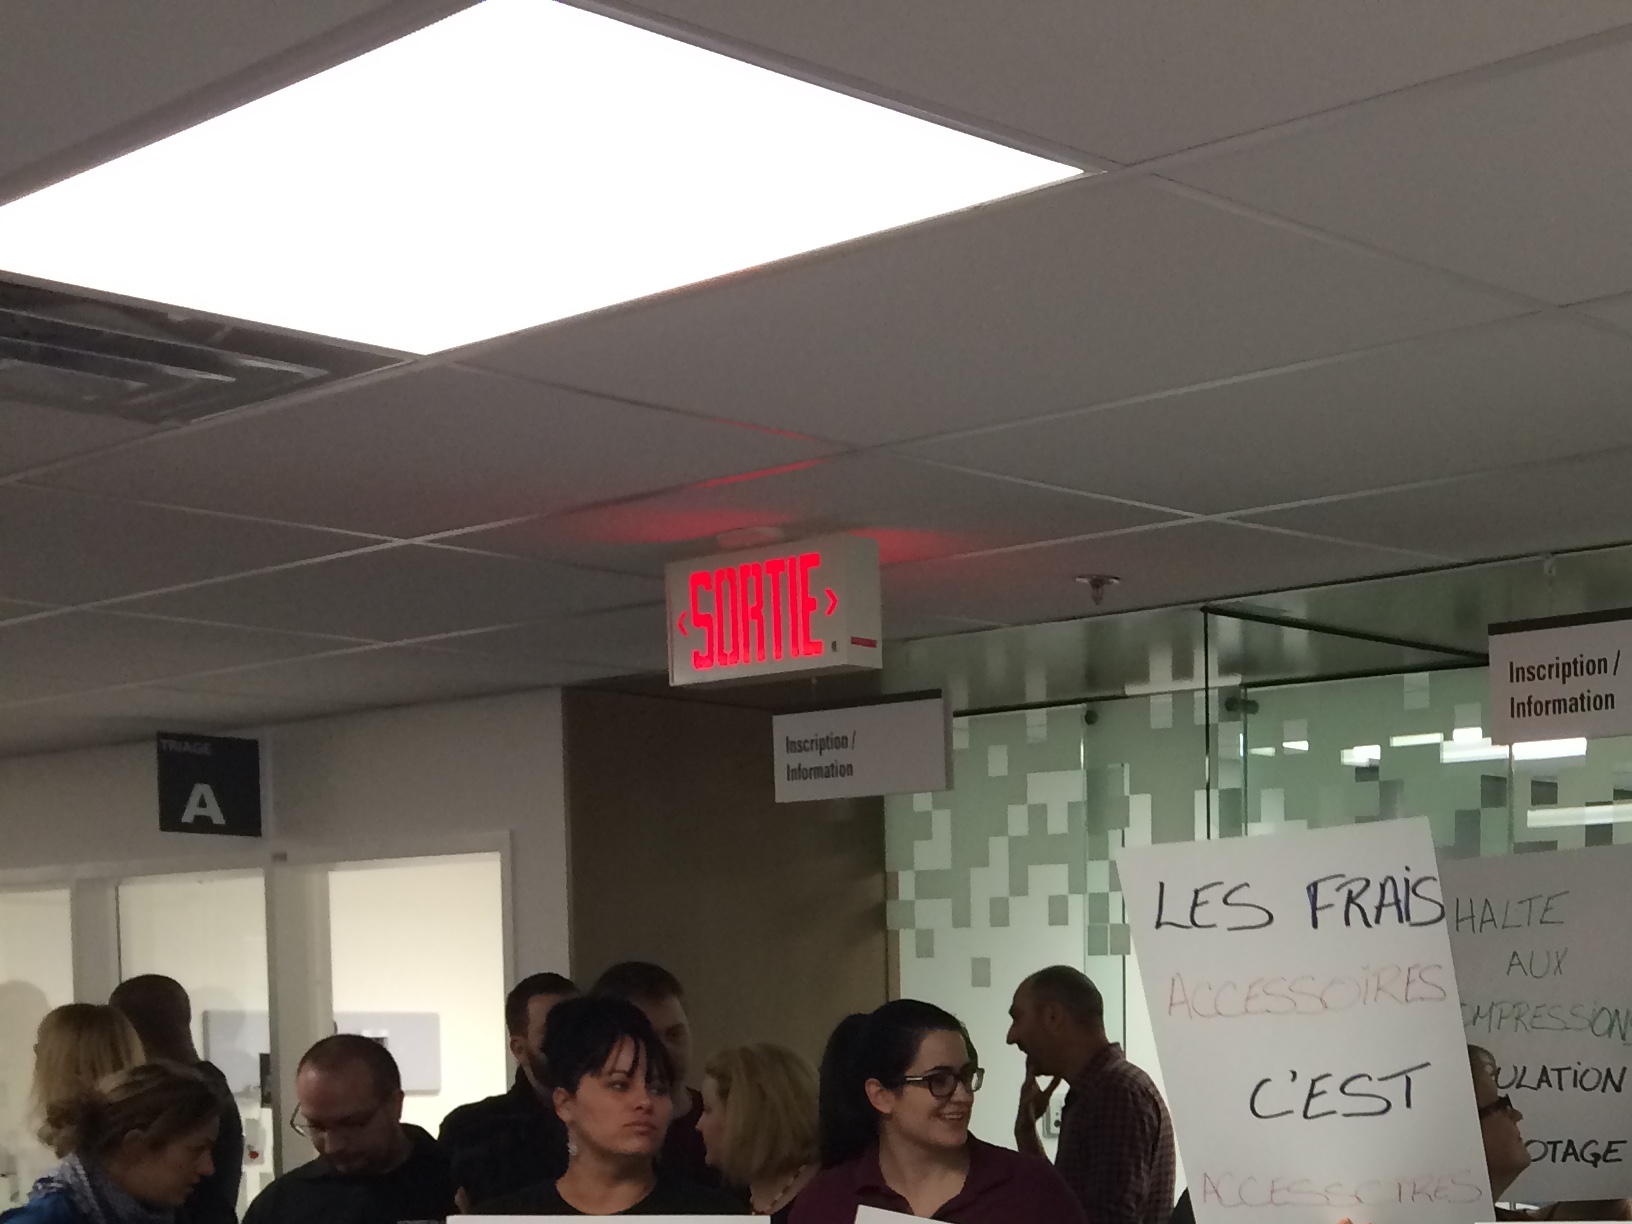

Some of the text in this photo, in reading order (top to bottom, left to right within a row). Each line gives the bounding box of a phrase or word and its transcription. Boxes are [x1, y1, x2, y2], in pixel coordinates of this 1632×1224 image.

[689, 552, 823, 669] SORTIE
[1509, 655, 1609, 685] Inscription
[1510, 690, 1616, 719] Information
[786, 732, 848, 756] Inscription
[786, 760, 853, 782] Information
[181, 782, 226, 825] A
[1155, 866, 1446, 931] LES FRAIS
[1455, 891, 1570, 934] HALTE
[1506, 946, 1568, 976] AUX
[1167, 963, 1447, 1019] ACCESSOIRES
[1249, 1061, 1431, 1120] C'EST
[1524, 1139, 1628, 1168] OTAGE
